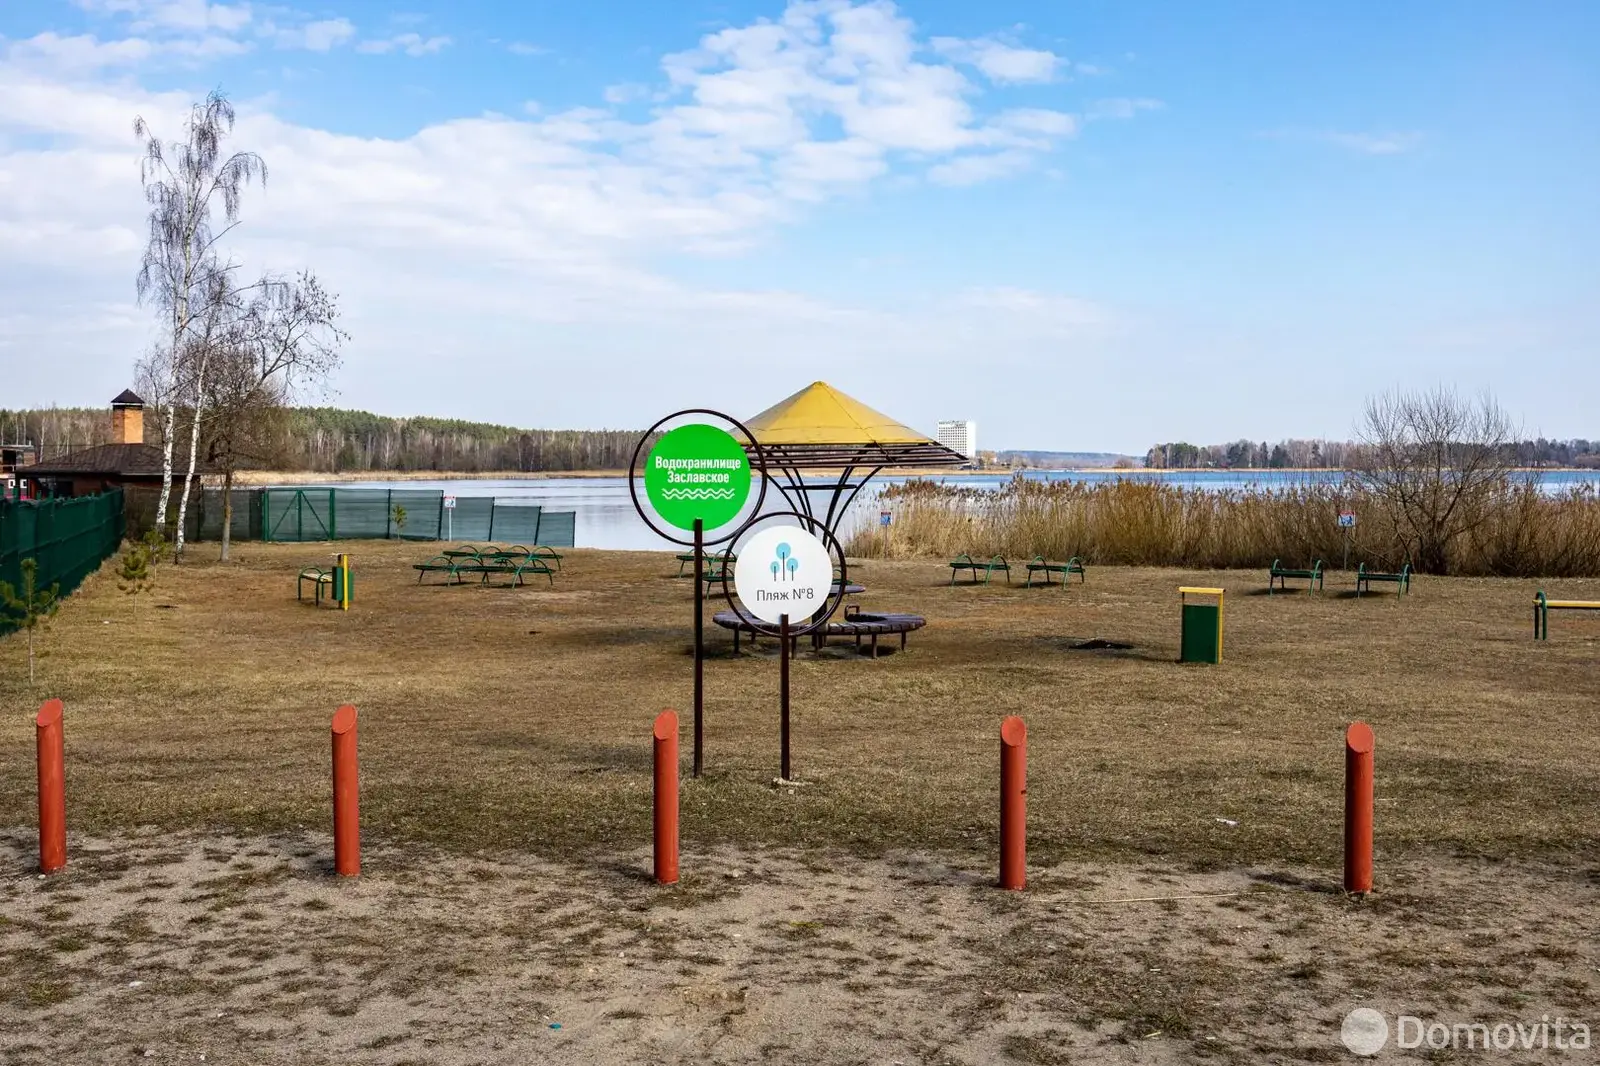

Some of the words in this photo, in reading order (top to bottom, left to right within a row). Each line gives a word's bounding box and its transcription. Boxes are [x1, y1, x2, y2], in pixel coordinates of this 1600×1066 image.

[655, 456, 741, 471] Водохранилище
[667, 470, 729, 483] Заславское
[756, 589, 789, 601] Пляж
